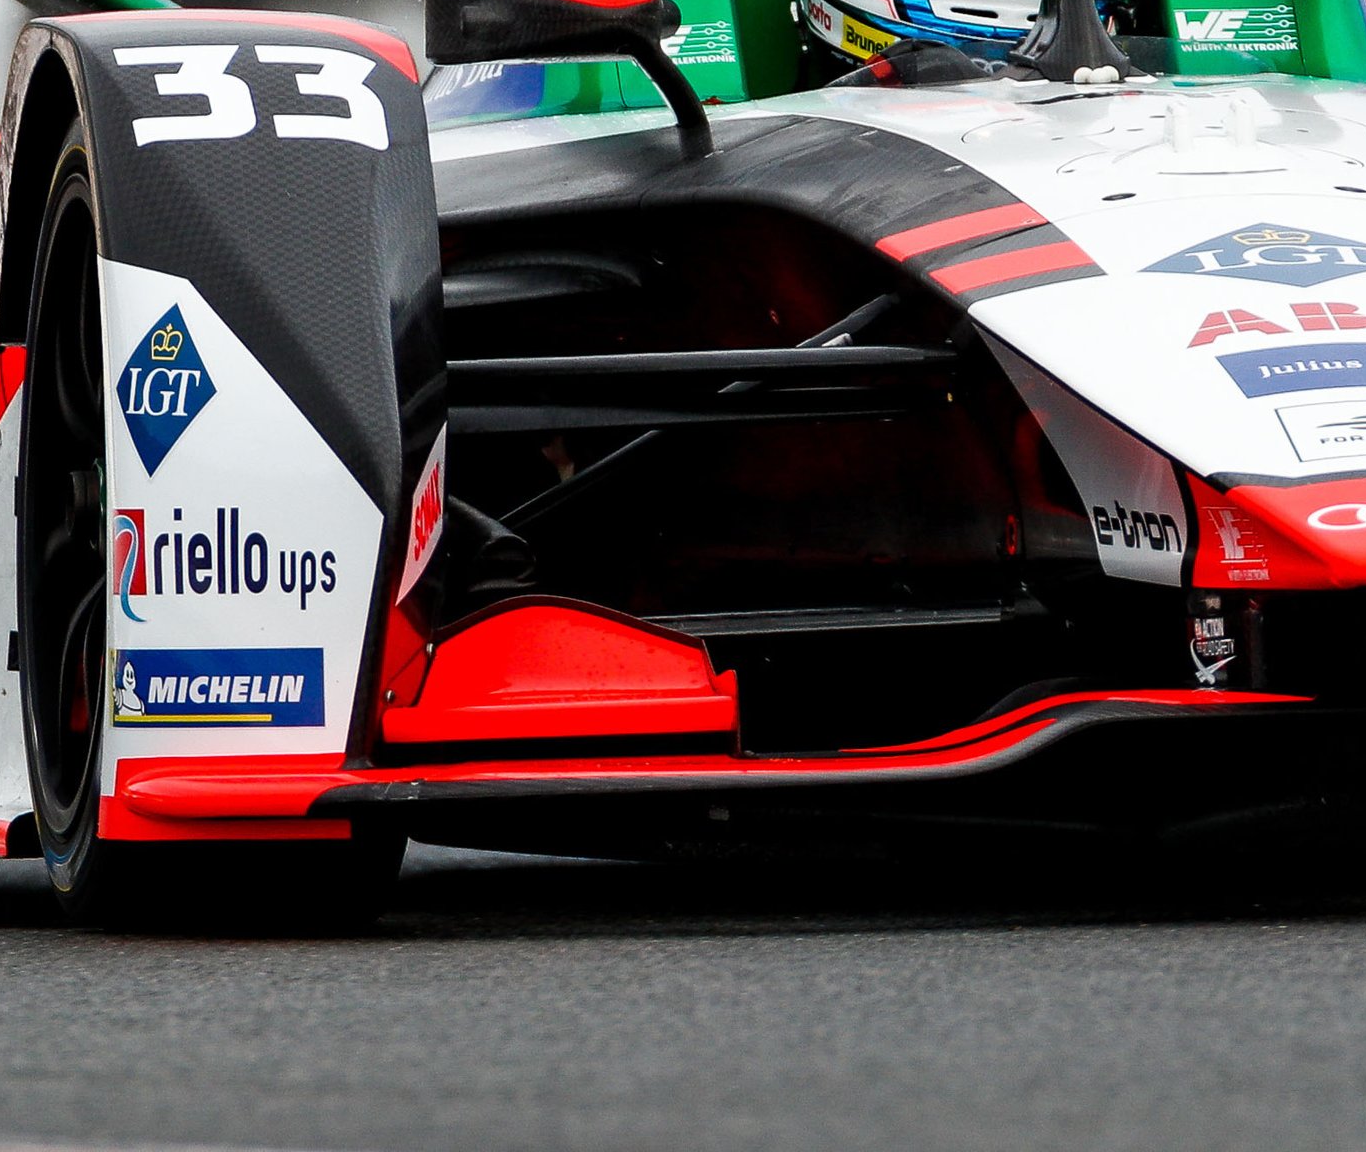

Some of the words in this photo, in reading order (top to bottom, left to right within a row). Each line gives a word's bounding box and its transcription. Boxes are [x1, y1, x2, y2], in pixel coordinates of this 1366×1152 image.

[1175, 11, 1248, 40] WE
[112, 44, 390, 151] 33
[125, 367, 201, 416] LGT
[1258, 357, 1363, 378] Julius
[1093, 500, 1182, 553] e-tron
[153, 507, 268, 595] riello
[279, 549, 337, 609] ups
[147, 674, 305, 704] MICHELIN
